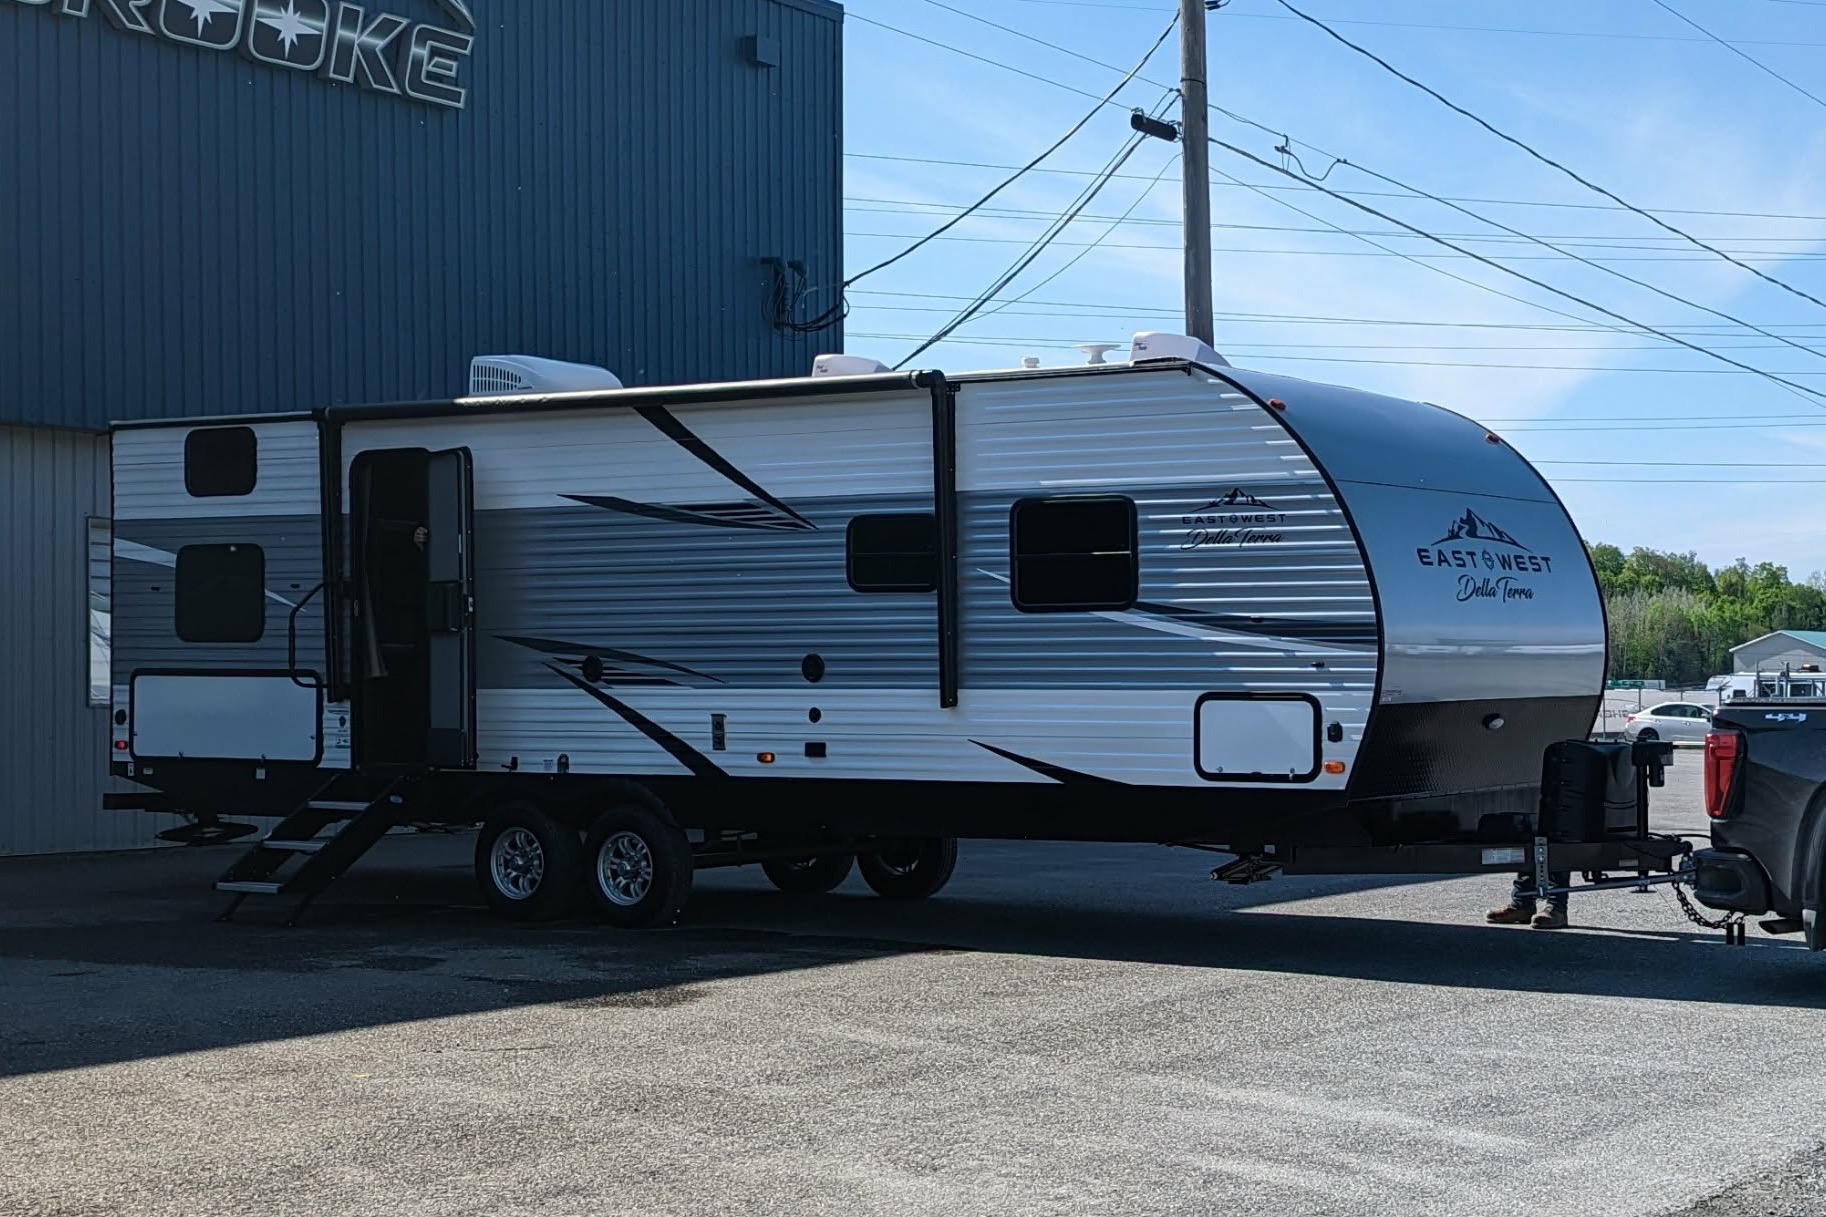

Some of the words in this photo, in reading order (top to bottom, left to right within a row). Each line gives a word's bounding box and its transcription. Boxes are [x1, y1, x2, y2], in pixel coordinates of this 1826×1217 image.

[16, 0, 474, 109] OOKE
[1182, 515, 1226, 524] EAST
[1241, 513, 1286, 523] WEST
[1180, 528, 1234, 550] Della
[1235, 526, 1282, 548] Terra
[1416, 548, 1478, 568] EAST
[1495, 552, 1552, 573] WEST
[1456, 574, 1497, 602] Della
[1496, 576, 1534, 603] Terra
